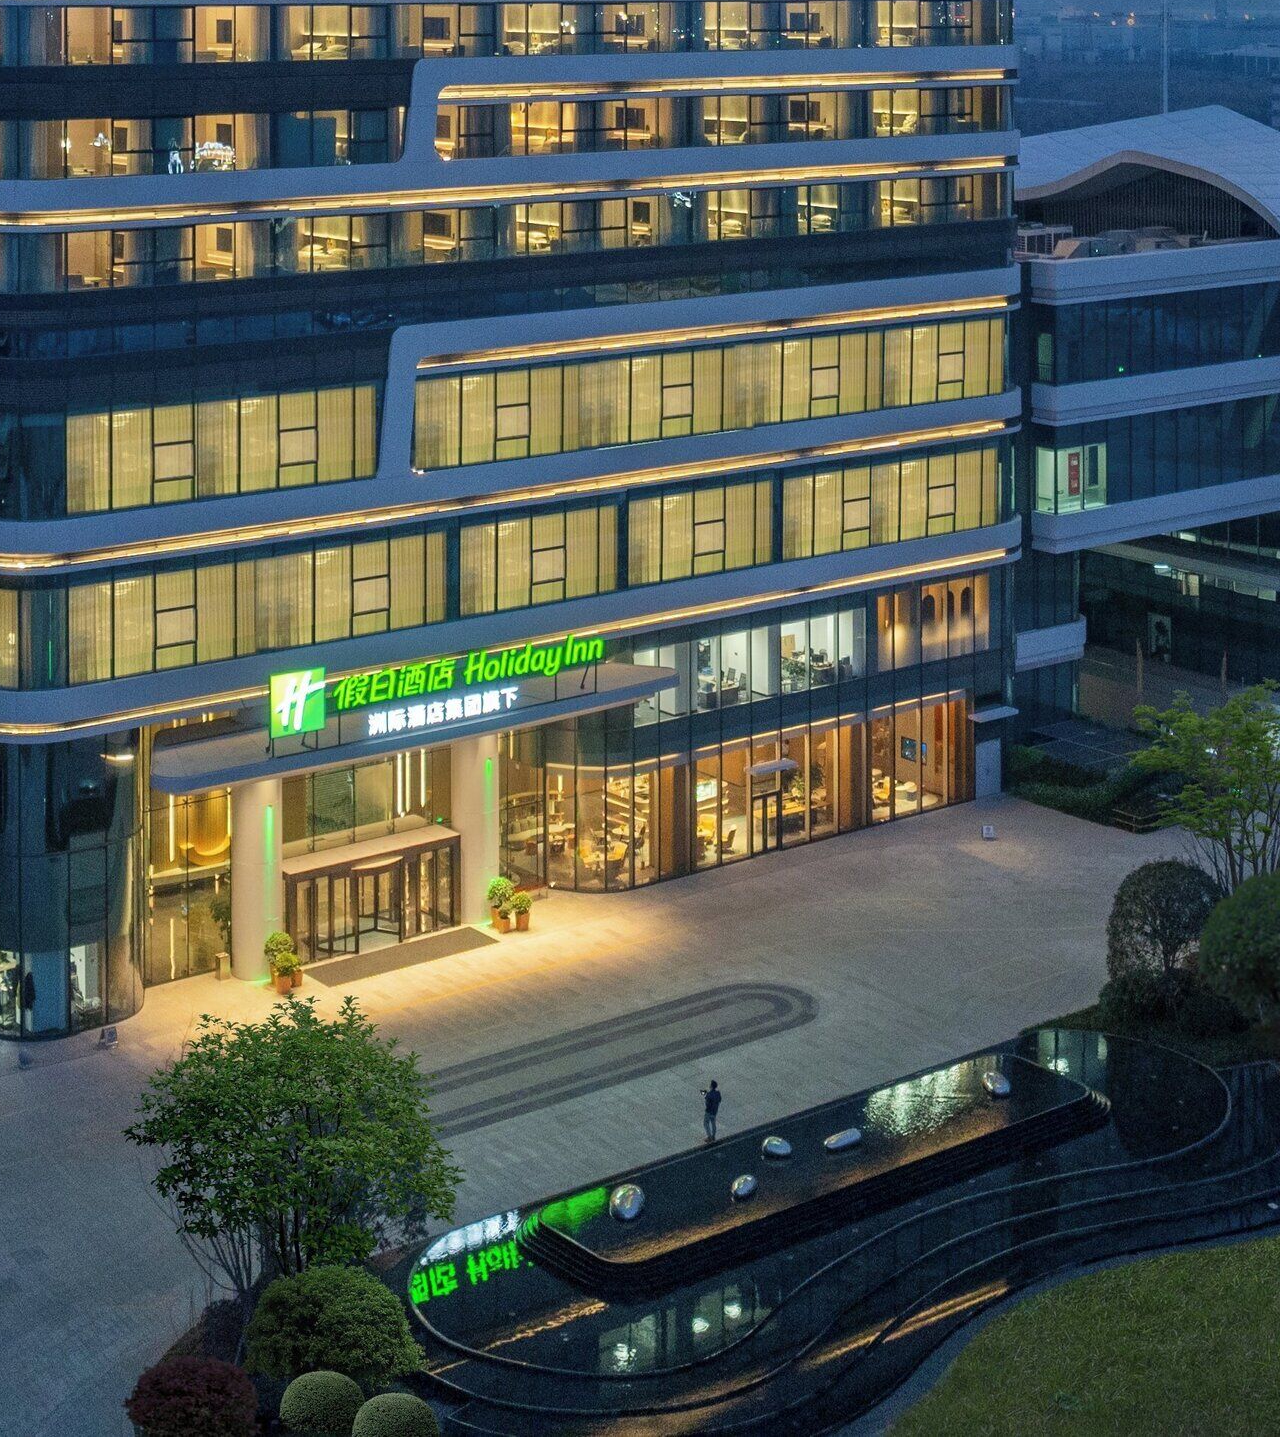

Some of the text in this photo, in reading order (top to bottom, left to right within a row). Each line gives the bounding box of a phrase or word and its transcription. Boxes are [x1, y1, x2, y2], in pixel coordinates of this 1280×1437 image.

[333, 633, 605, 710] 假日酒店 Holiday Inn
[368, 687, 519, 736] 洲际酒店集团旗下
